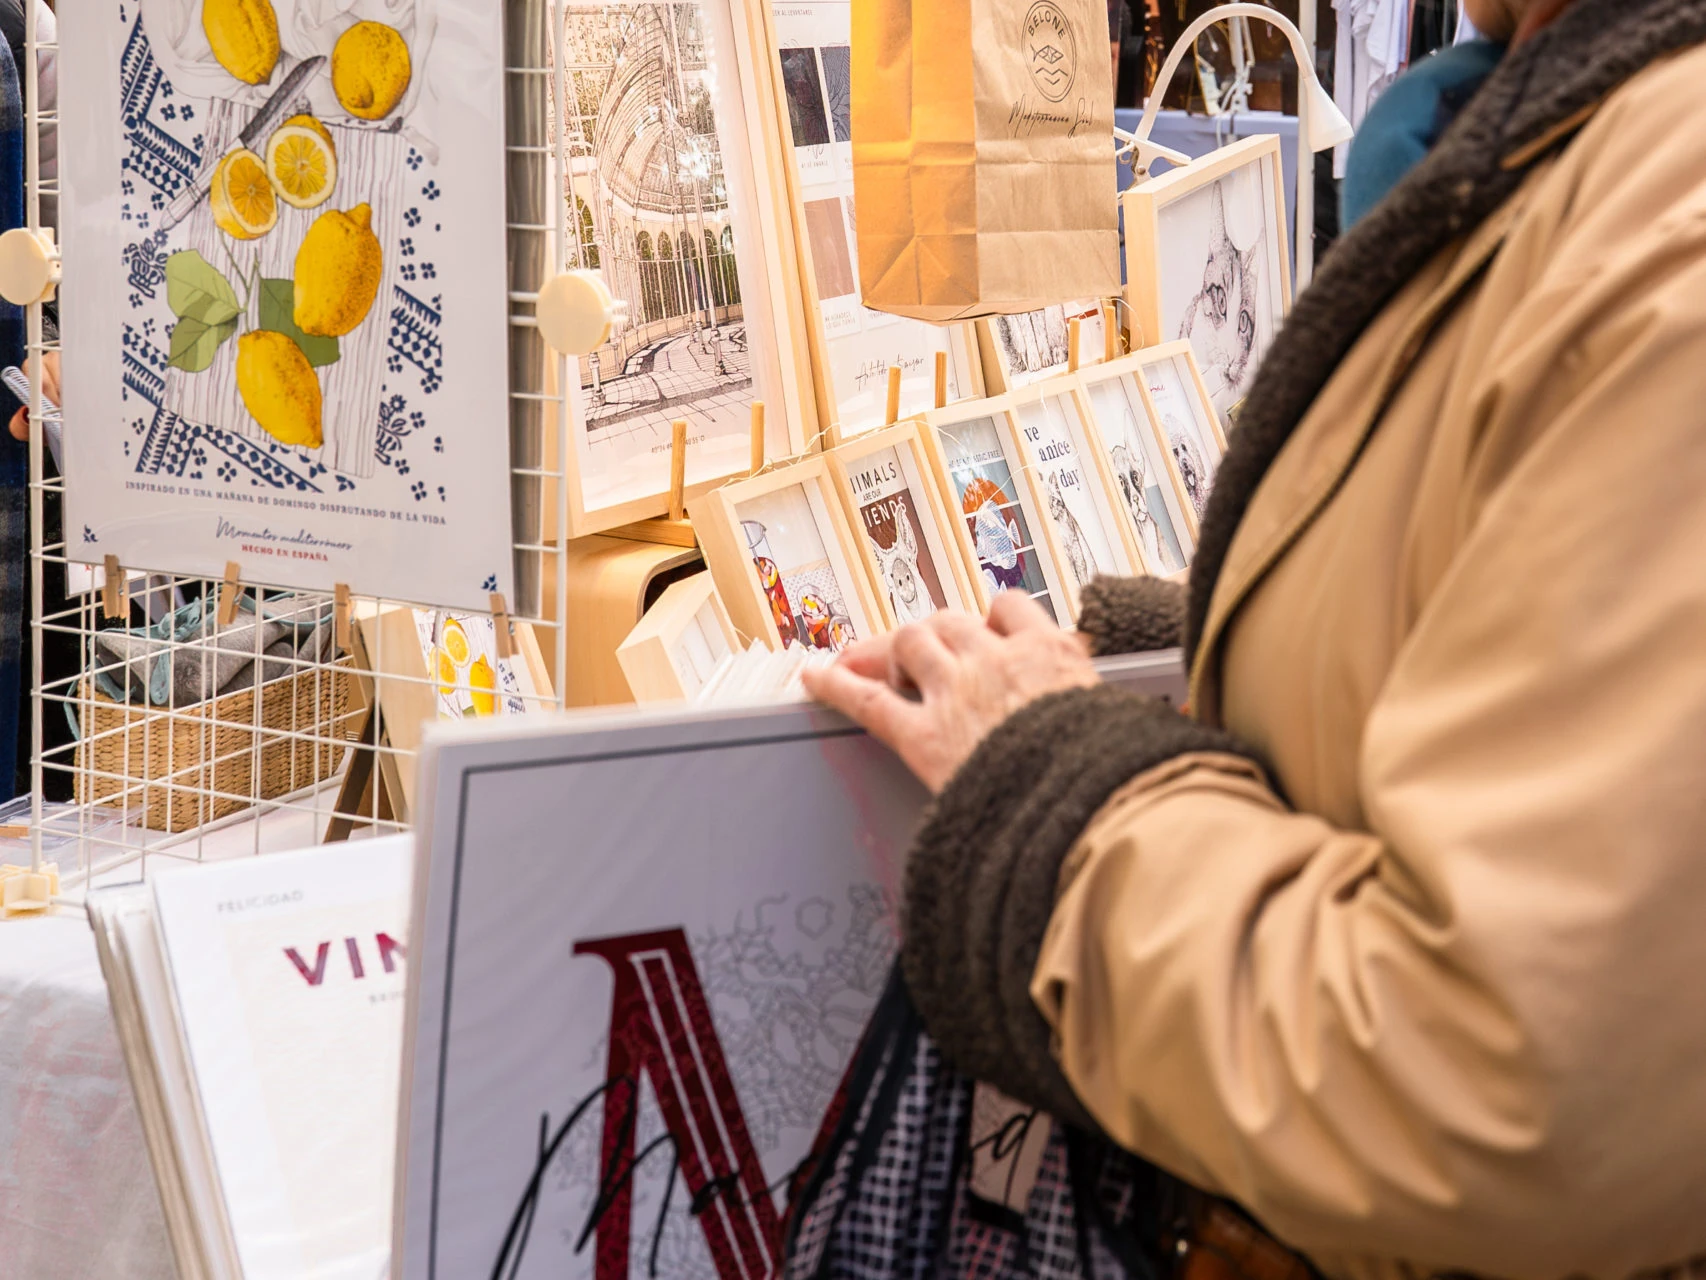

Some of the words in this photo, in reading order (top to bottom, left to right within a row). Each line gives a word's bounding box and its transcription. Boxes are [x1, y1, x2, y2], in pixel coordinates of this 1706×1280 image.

[1028, 10, 1066, 40] BELONE
[1060, 468, 1080, 491] day
[125, 481, 175, 494] INSPIRADO
[178, 486, 190, 495] EN
[194, 488, 212, 498] UNA
[216, 490, 254, 503] MAÑANA
[258, 496, 269, 505] DE
[273, 497, 316, 510] DOMINGO
[320, 503, 386, 518] DISFRUTANDO
[390, 511, 402, 520] DE
[406, 512, 418, 522] LA
[422, 514, 446, 525] VIDA
[216, 515, 278, 541] Momentos
[241, 544, 273, 555] HECHO
[277, 548, 288, 556] EN
[292, 550, 328, 562] ESPAÑA
